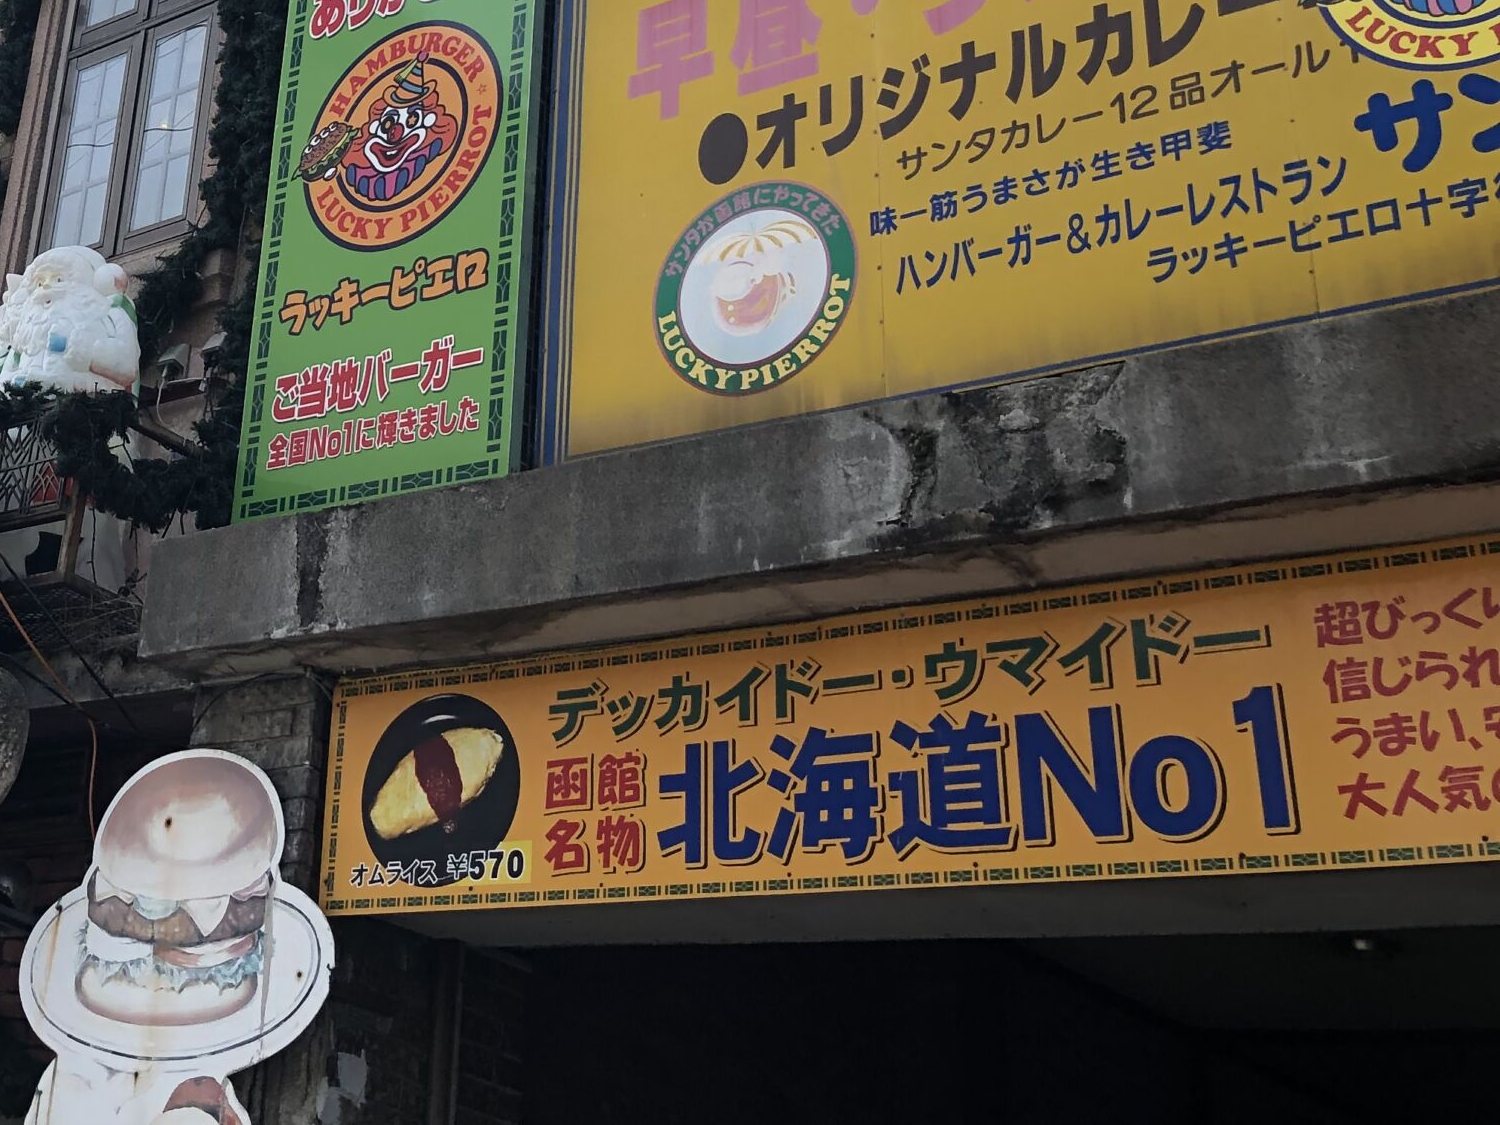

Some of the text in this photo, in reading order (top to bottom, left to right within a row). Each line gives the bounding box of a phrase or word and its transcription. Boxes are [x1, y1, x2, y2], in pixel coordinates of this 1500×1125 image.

[329, 31, 485, 117] HAMBURGER
[1346, 6, 1480, 59] LUCKY
[316, 104, 493, 239] LUCKY PIERROT
[869, 120, 1233, 236] 味一筋うまさが生き甲斐
[664, 186, 841, 278] サンタが函館にやってきた
[1146, 171, 1500, 284] ラッキーピエロ十字
[279, 247, 490, 335] ラッキーピエロ
[658, 273, 851, 390] LUCKY PIERROT
[271, 334, 485, 423] ご当地バーガー
[266, 395, 481, 471] 全国No1に輝きました
[548, 611, 1270, 746] デッカイドー・ウマイドー
[543, 751, 644, 812] 函館
[1337, 766, 1500, 820] 大人気
[350, 848, 526, 888] オムライス ¥570
[543, 815, 644, 873] 名物
